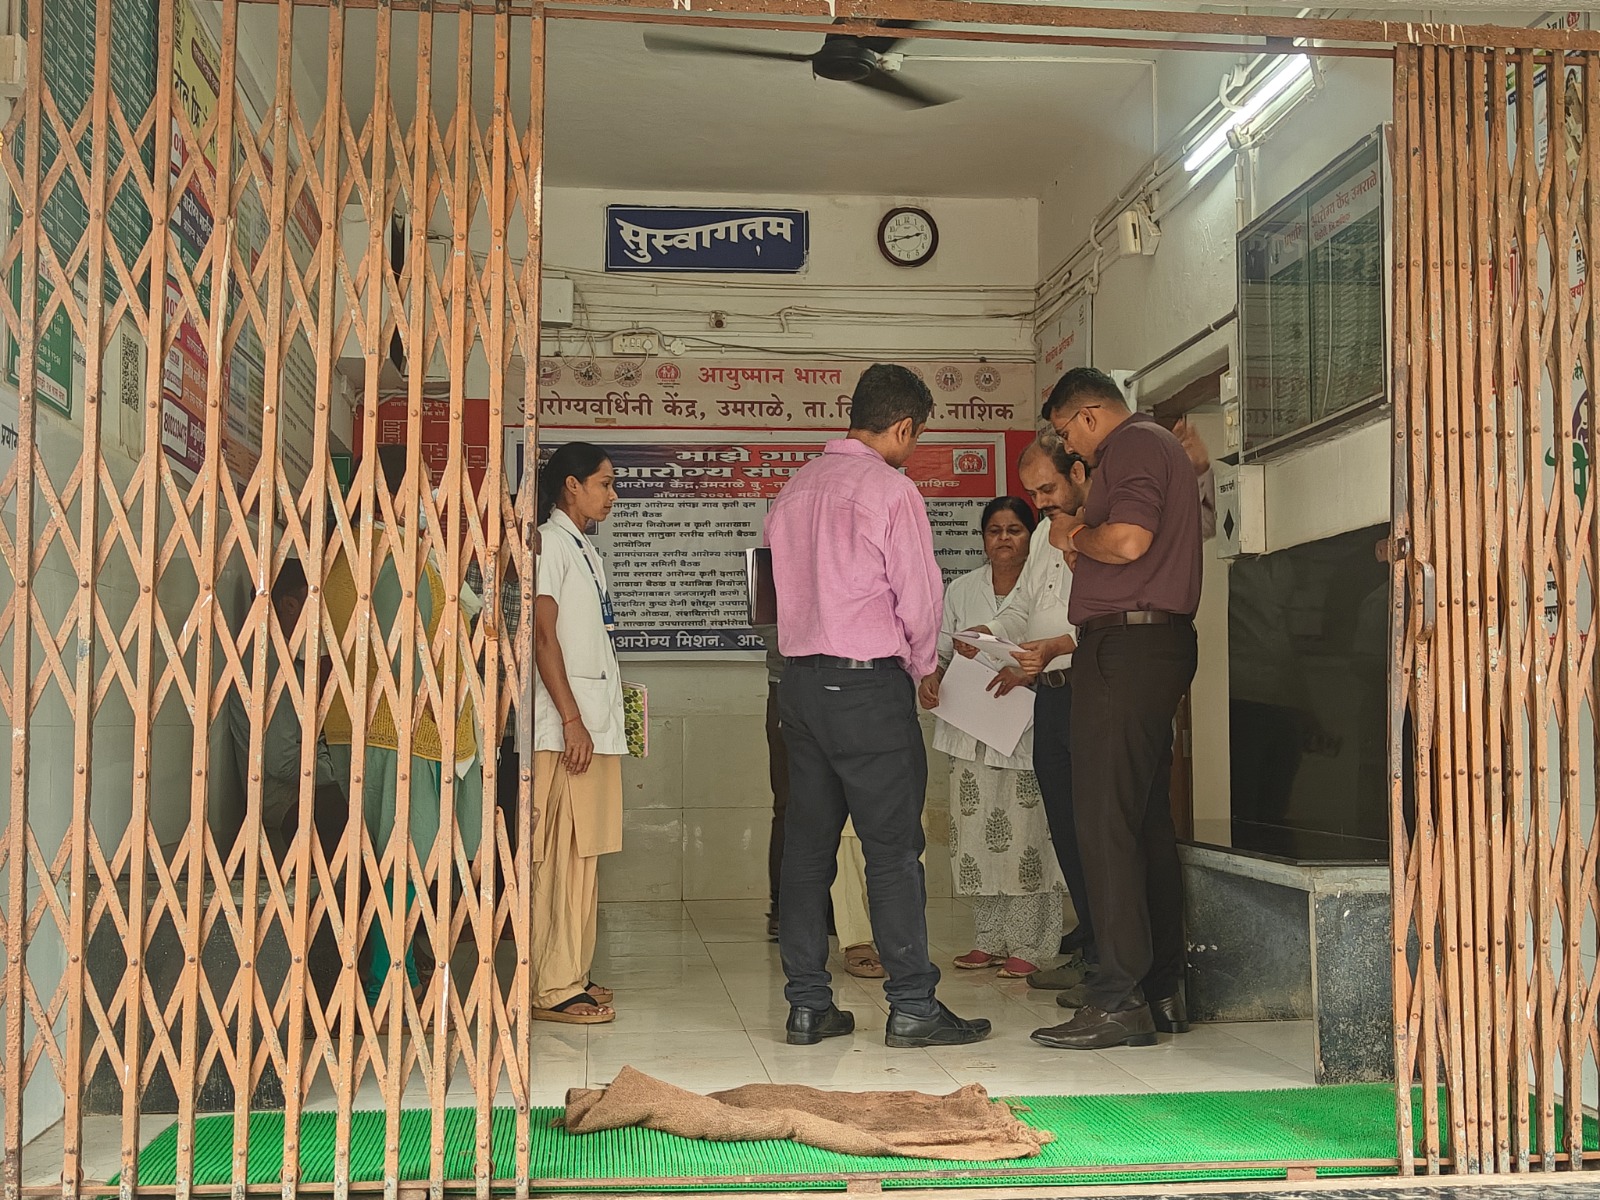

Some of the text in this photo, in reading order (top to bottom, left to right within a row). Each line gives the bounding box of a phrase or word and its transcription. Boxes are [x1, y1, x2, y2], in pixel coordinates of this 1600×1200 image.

[698, 366, 784, 390] आयुष्मान
[795, 368, 842, 385] भारत
[662, 392, 705, 420] केंद्र,
[716, 393, 792, 421] उमराळे,
[930, 396, 1014, 420] .नाशिक
[676, 447, 751, 462] माझे
[613, 463, 802, 478] आरोग्य संप
[616, 479, 664, 488] आरोग्य
[722, 500, 739, 510] कृती
[612, 510, 639, 518] समिती
[612, 520, 643, 528] आरोग्य
[694, 520, 711, 530] कृती
[708, 530, 733, 538] समिती
[691, 550, 721, 558] आरोग्य
[612, 560, 630, 570] कृती
[651, 560, 677, 568] समिती
[666, 570, 696, 578] आरोग्य
[699, 569, 716, 579] कृती
[616, 632, 670, 648] आरोग्य
[676, 631, 725, 648] मिशन.
